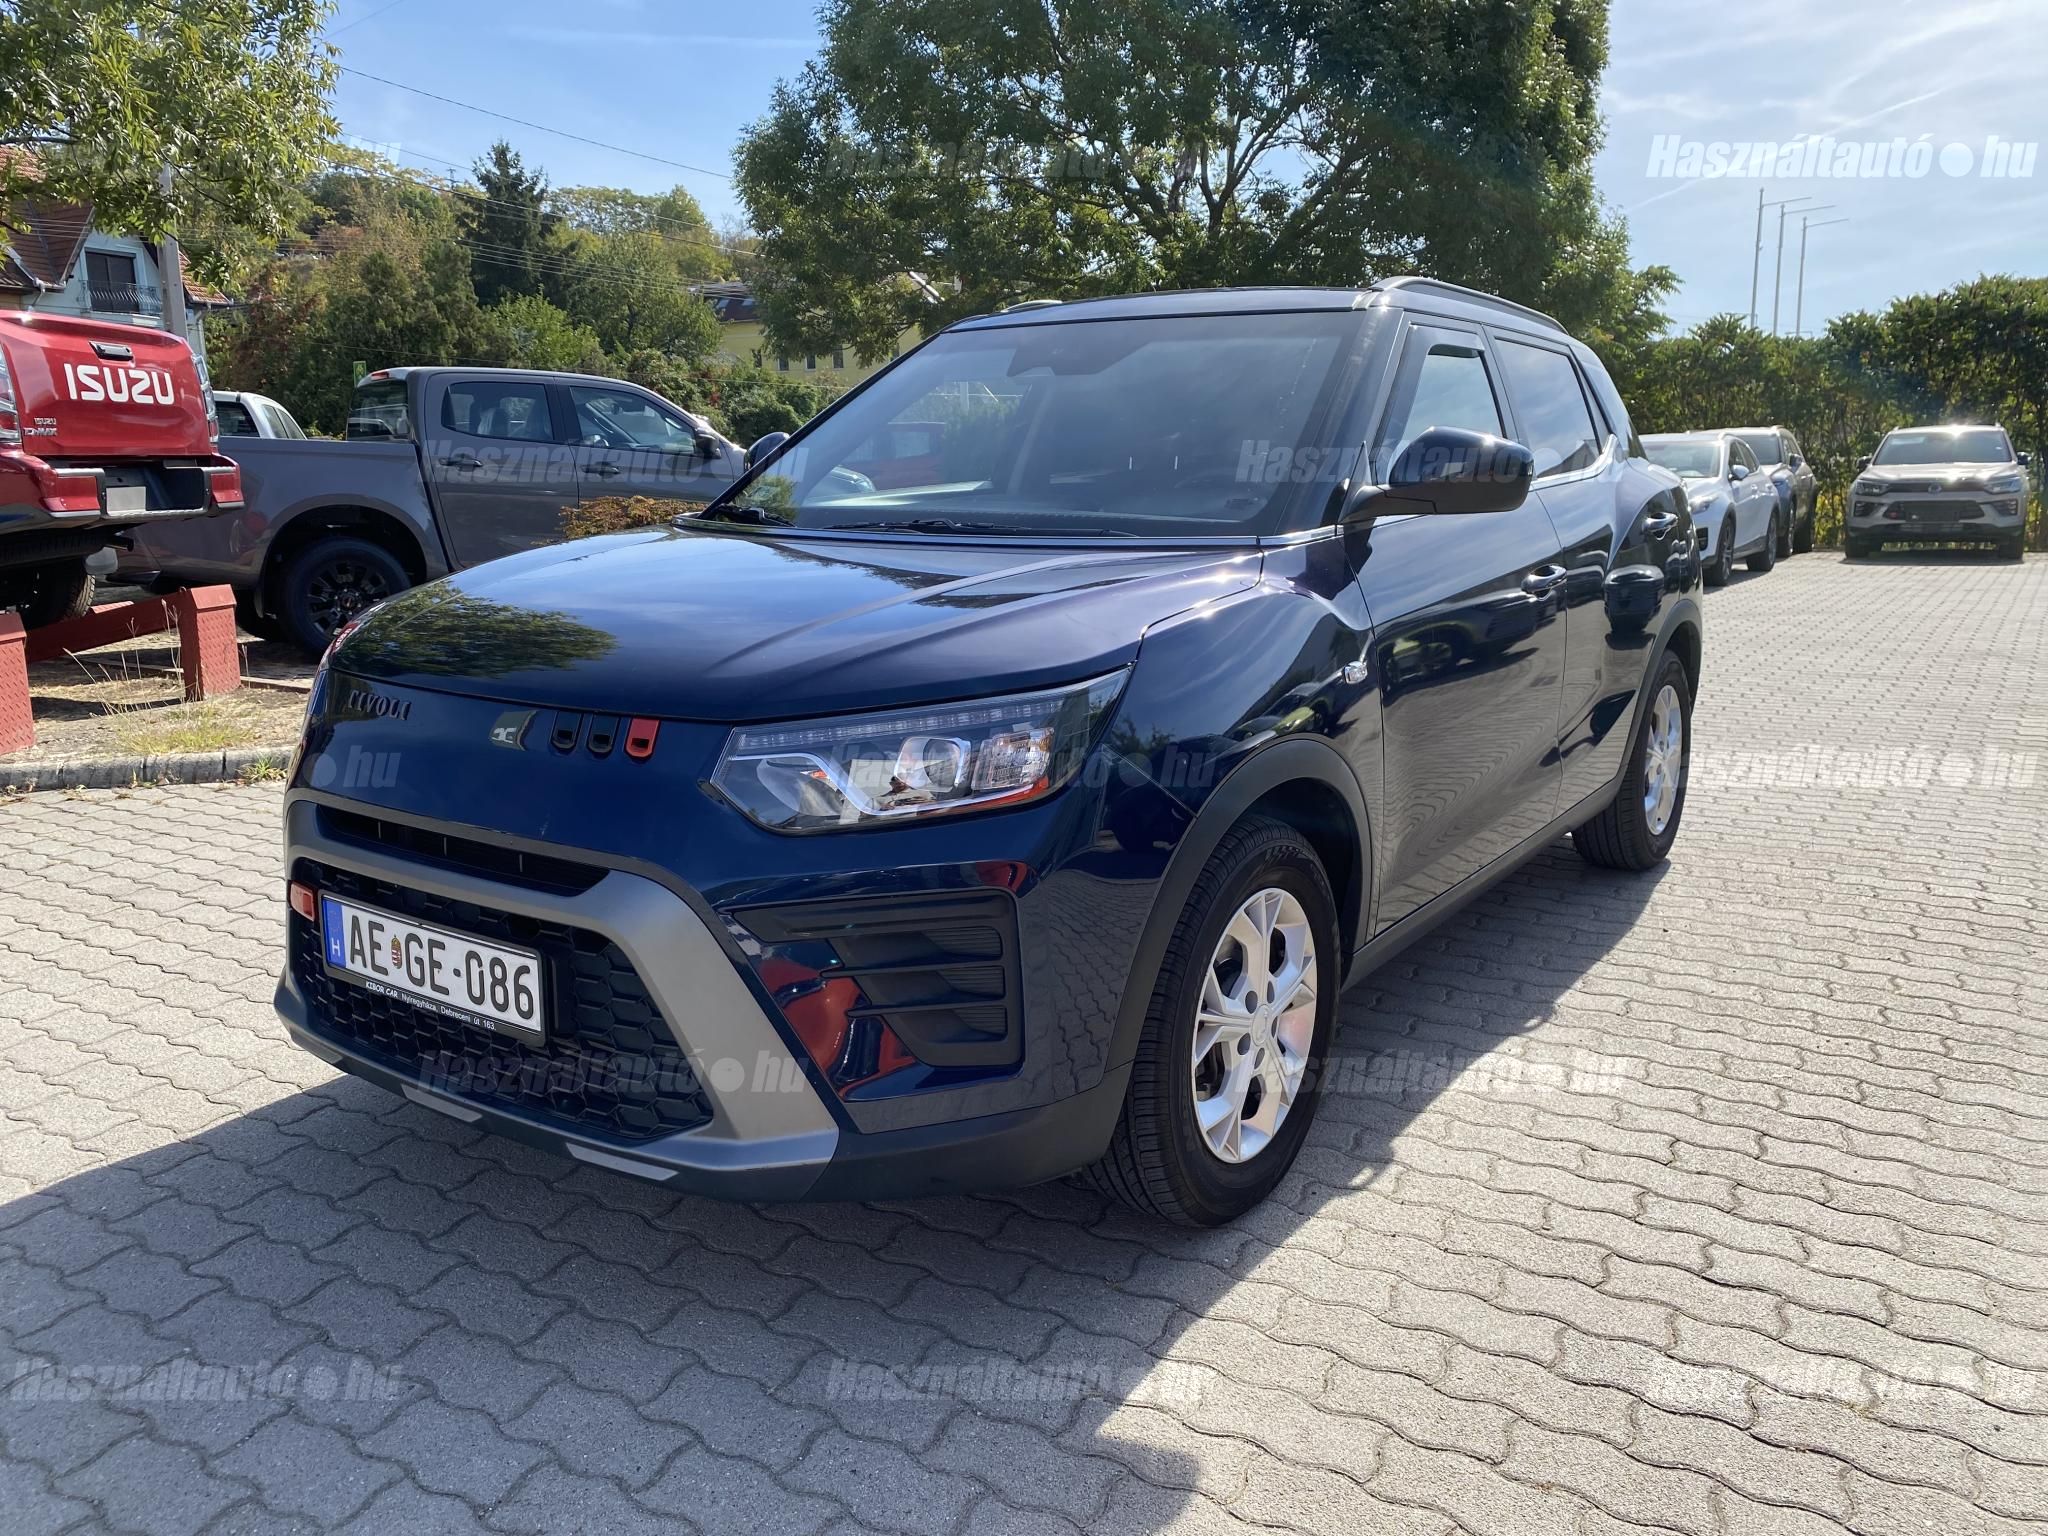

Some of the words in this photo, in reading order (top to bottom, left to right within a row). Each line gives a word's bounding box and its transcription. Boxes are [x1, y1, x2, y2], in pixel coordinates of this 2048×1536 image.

[64, 363, 175, 405] ISUZU
[348, 690, 412, 720] TIVOLI
[331, 937, 341, 957] H
[350, 915, 389, 976] AE
[386, 988, 399, 998] CAR
